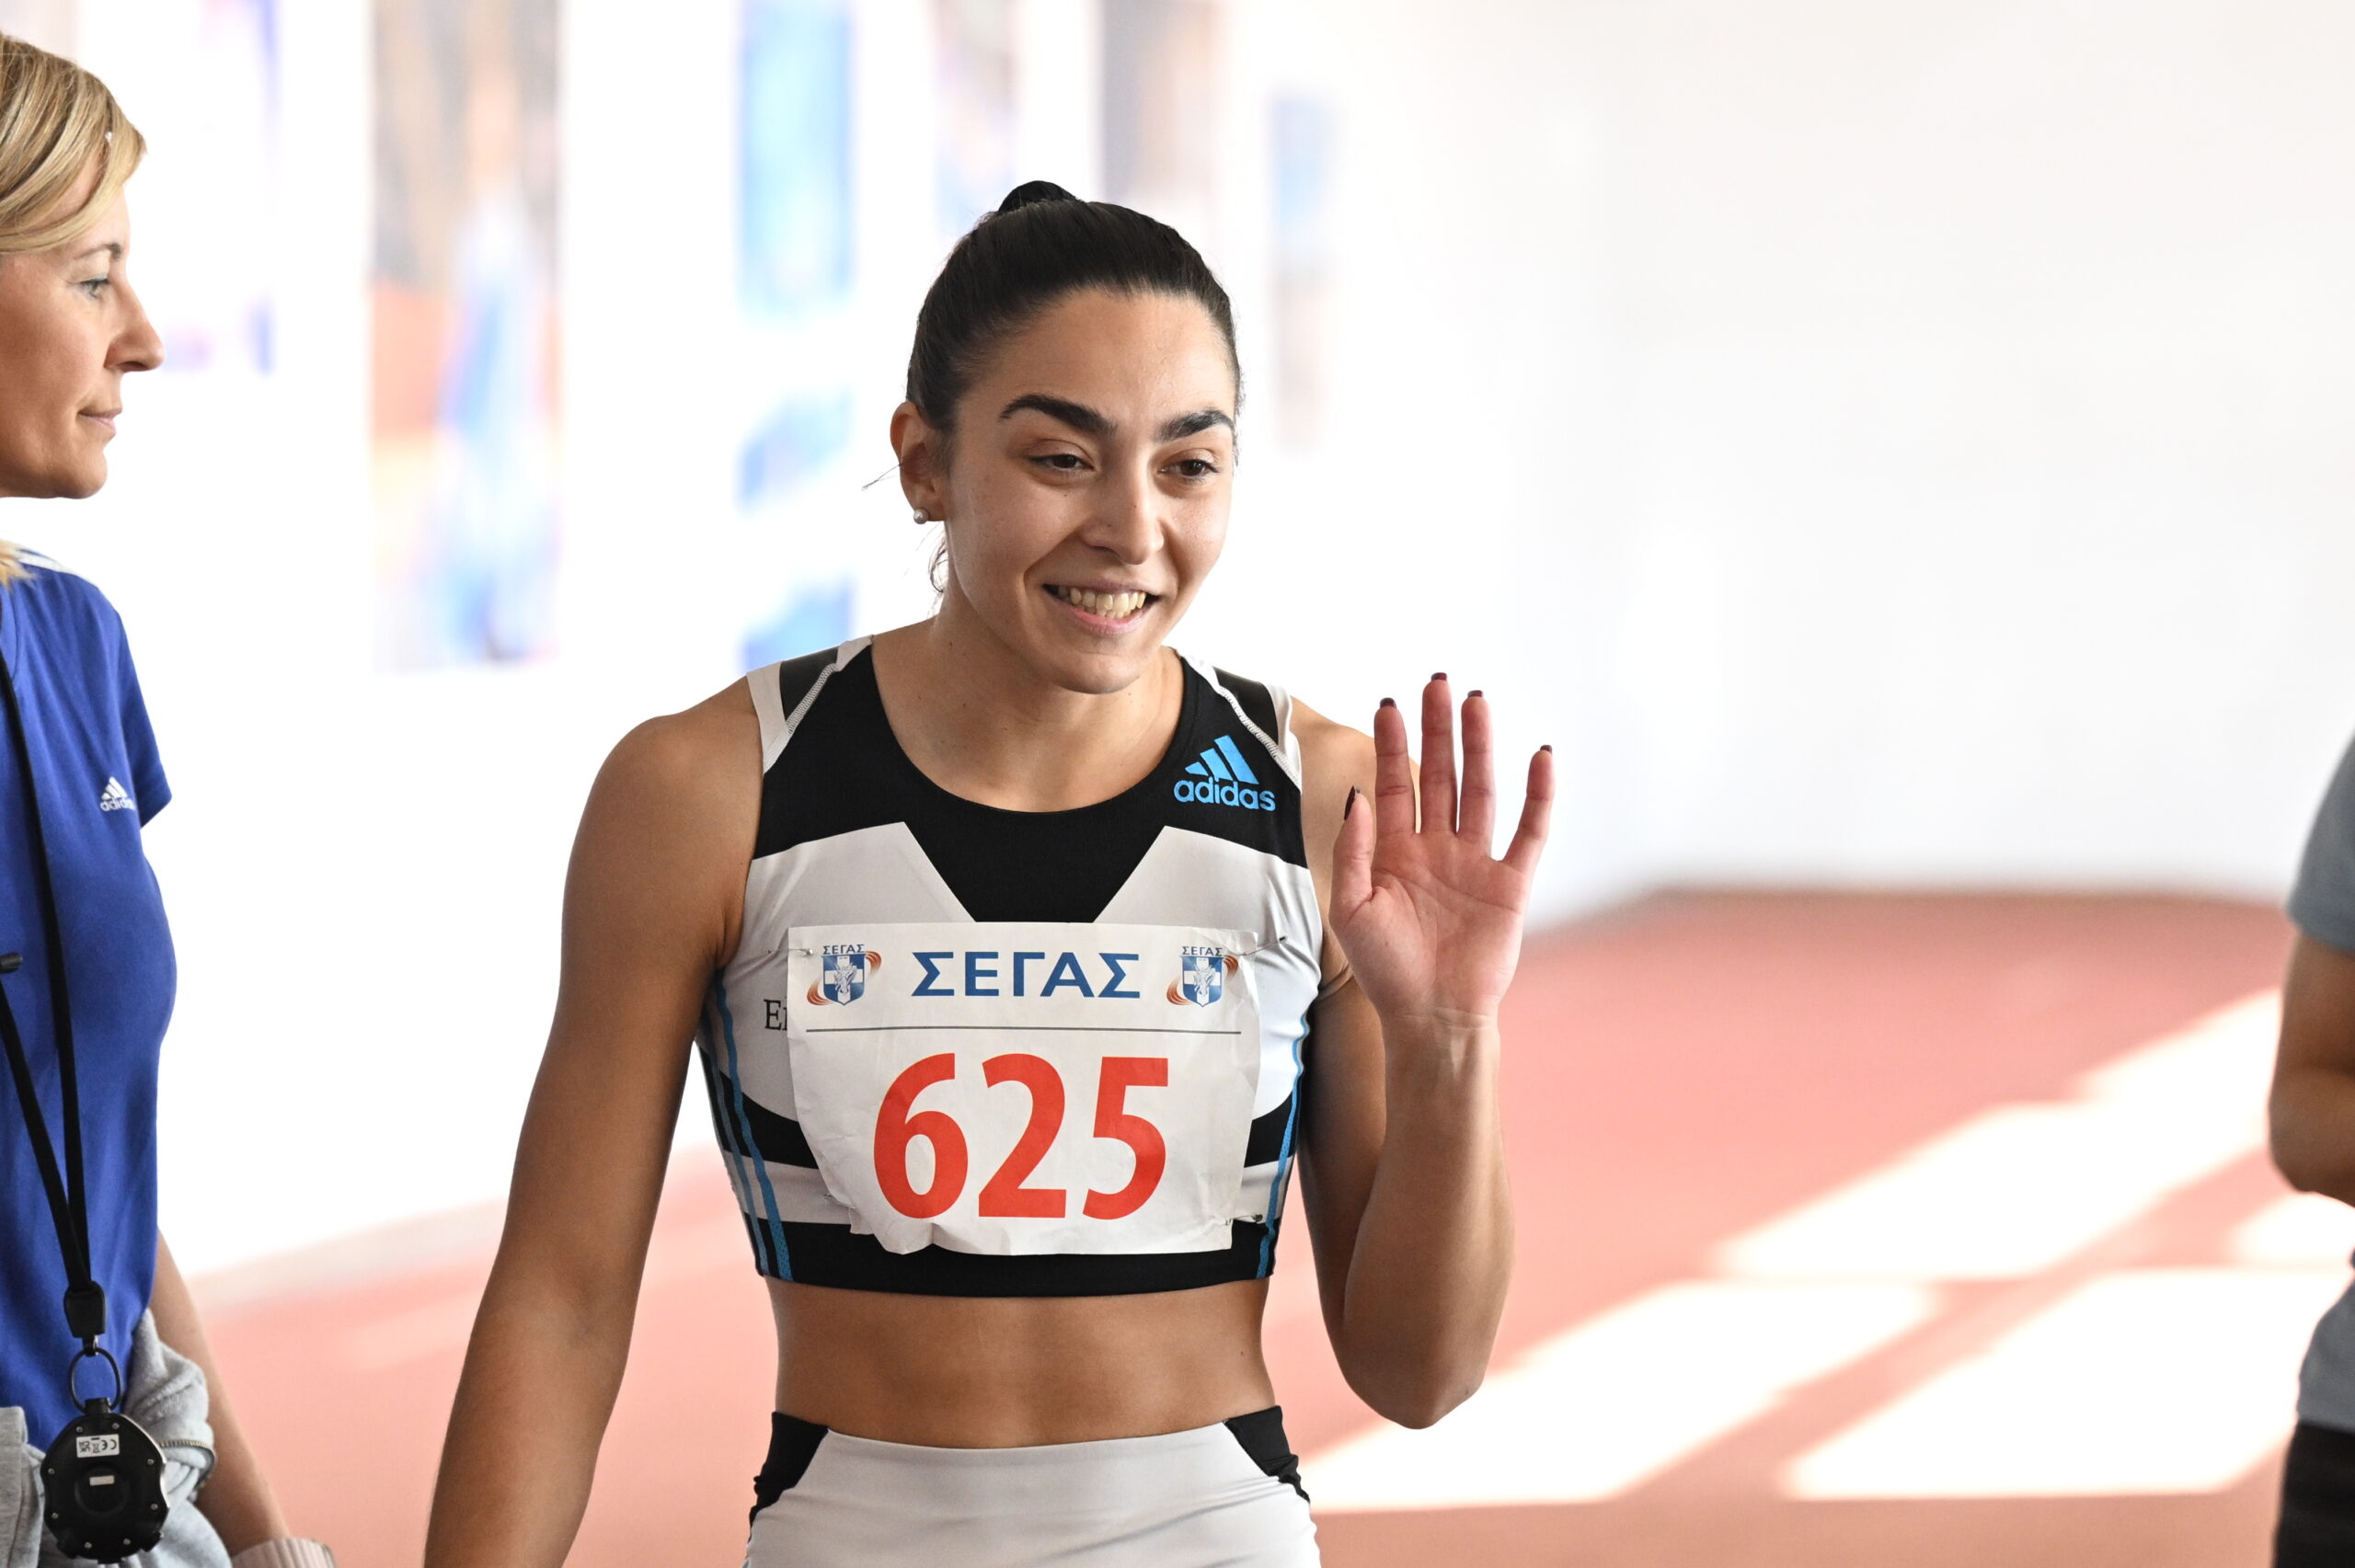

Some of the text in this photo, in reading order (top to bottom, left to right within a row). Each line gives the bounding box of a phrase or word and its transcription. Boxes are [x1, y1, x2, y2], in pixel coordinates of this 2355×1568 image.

[1173, 776, 1277, 812] adidas
[911, 951, 1142, 999] ΣΕΓΑΣ
[874, 1052, 1168, 1220] 625
